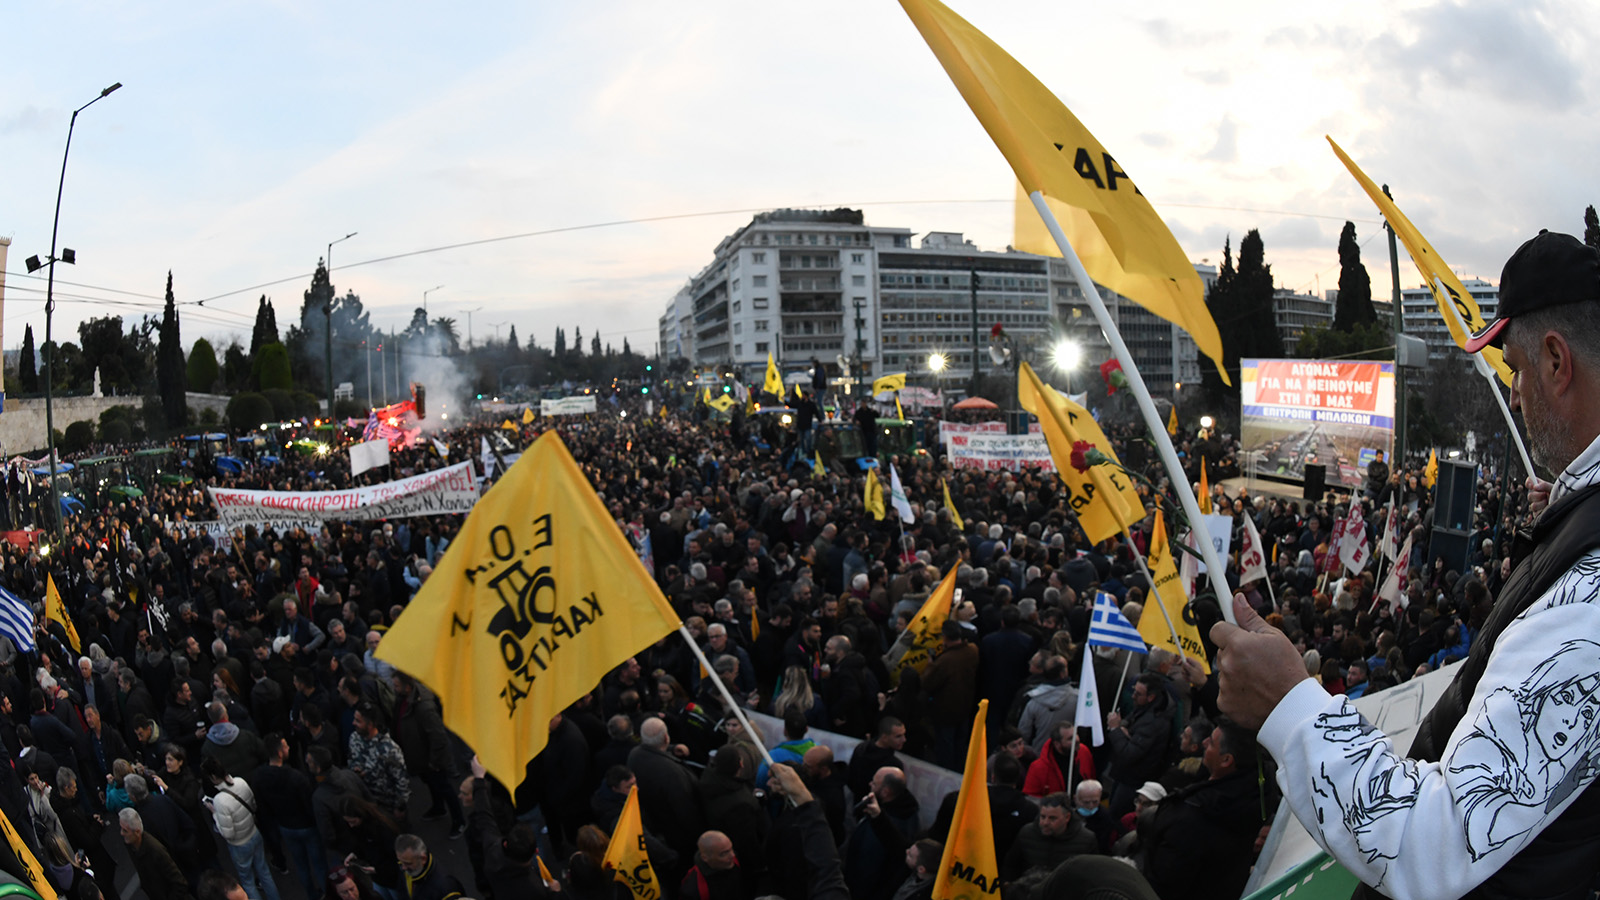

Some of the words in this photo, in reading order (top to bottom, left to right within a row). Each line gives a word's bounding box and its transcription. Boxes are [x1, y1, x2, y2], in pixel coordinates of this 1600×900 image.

[1291, 363, 1339, 377] ΑΓΩΝΑΣ
[1261, 377, 1281, 389] ΓΙΑ
[1285, 378, 1302, 391] ΝΑ
[1307, 379, 1373, 394] ΜΕΙΝΟΥΜΕ
[1278, 392, 1300, 405] ΣΤΗ
[1305, 393, 1321, 406] ΓΗ
[1326, 395, 1353, 409] ΜΑΣ
[1263, 407, 1312, 420] ΕΠΙΤΡΟΠΗ
[1316, 411, 1371, 425] ΜΠΛΟΚΩΝ
